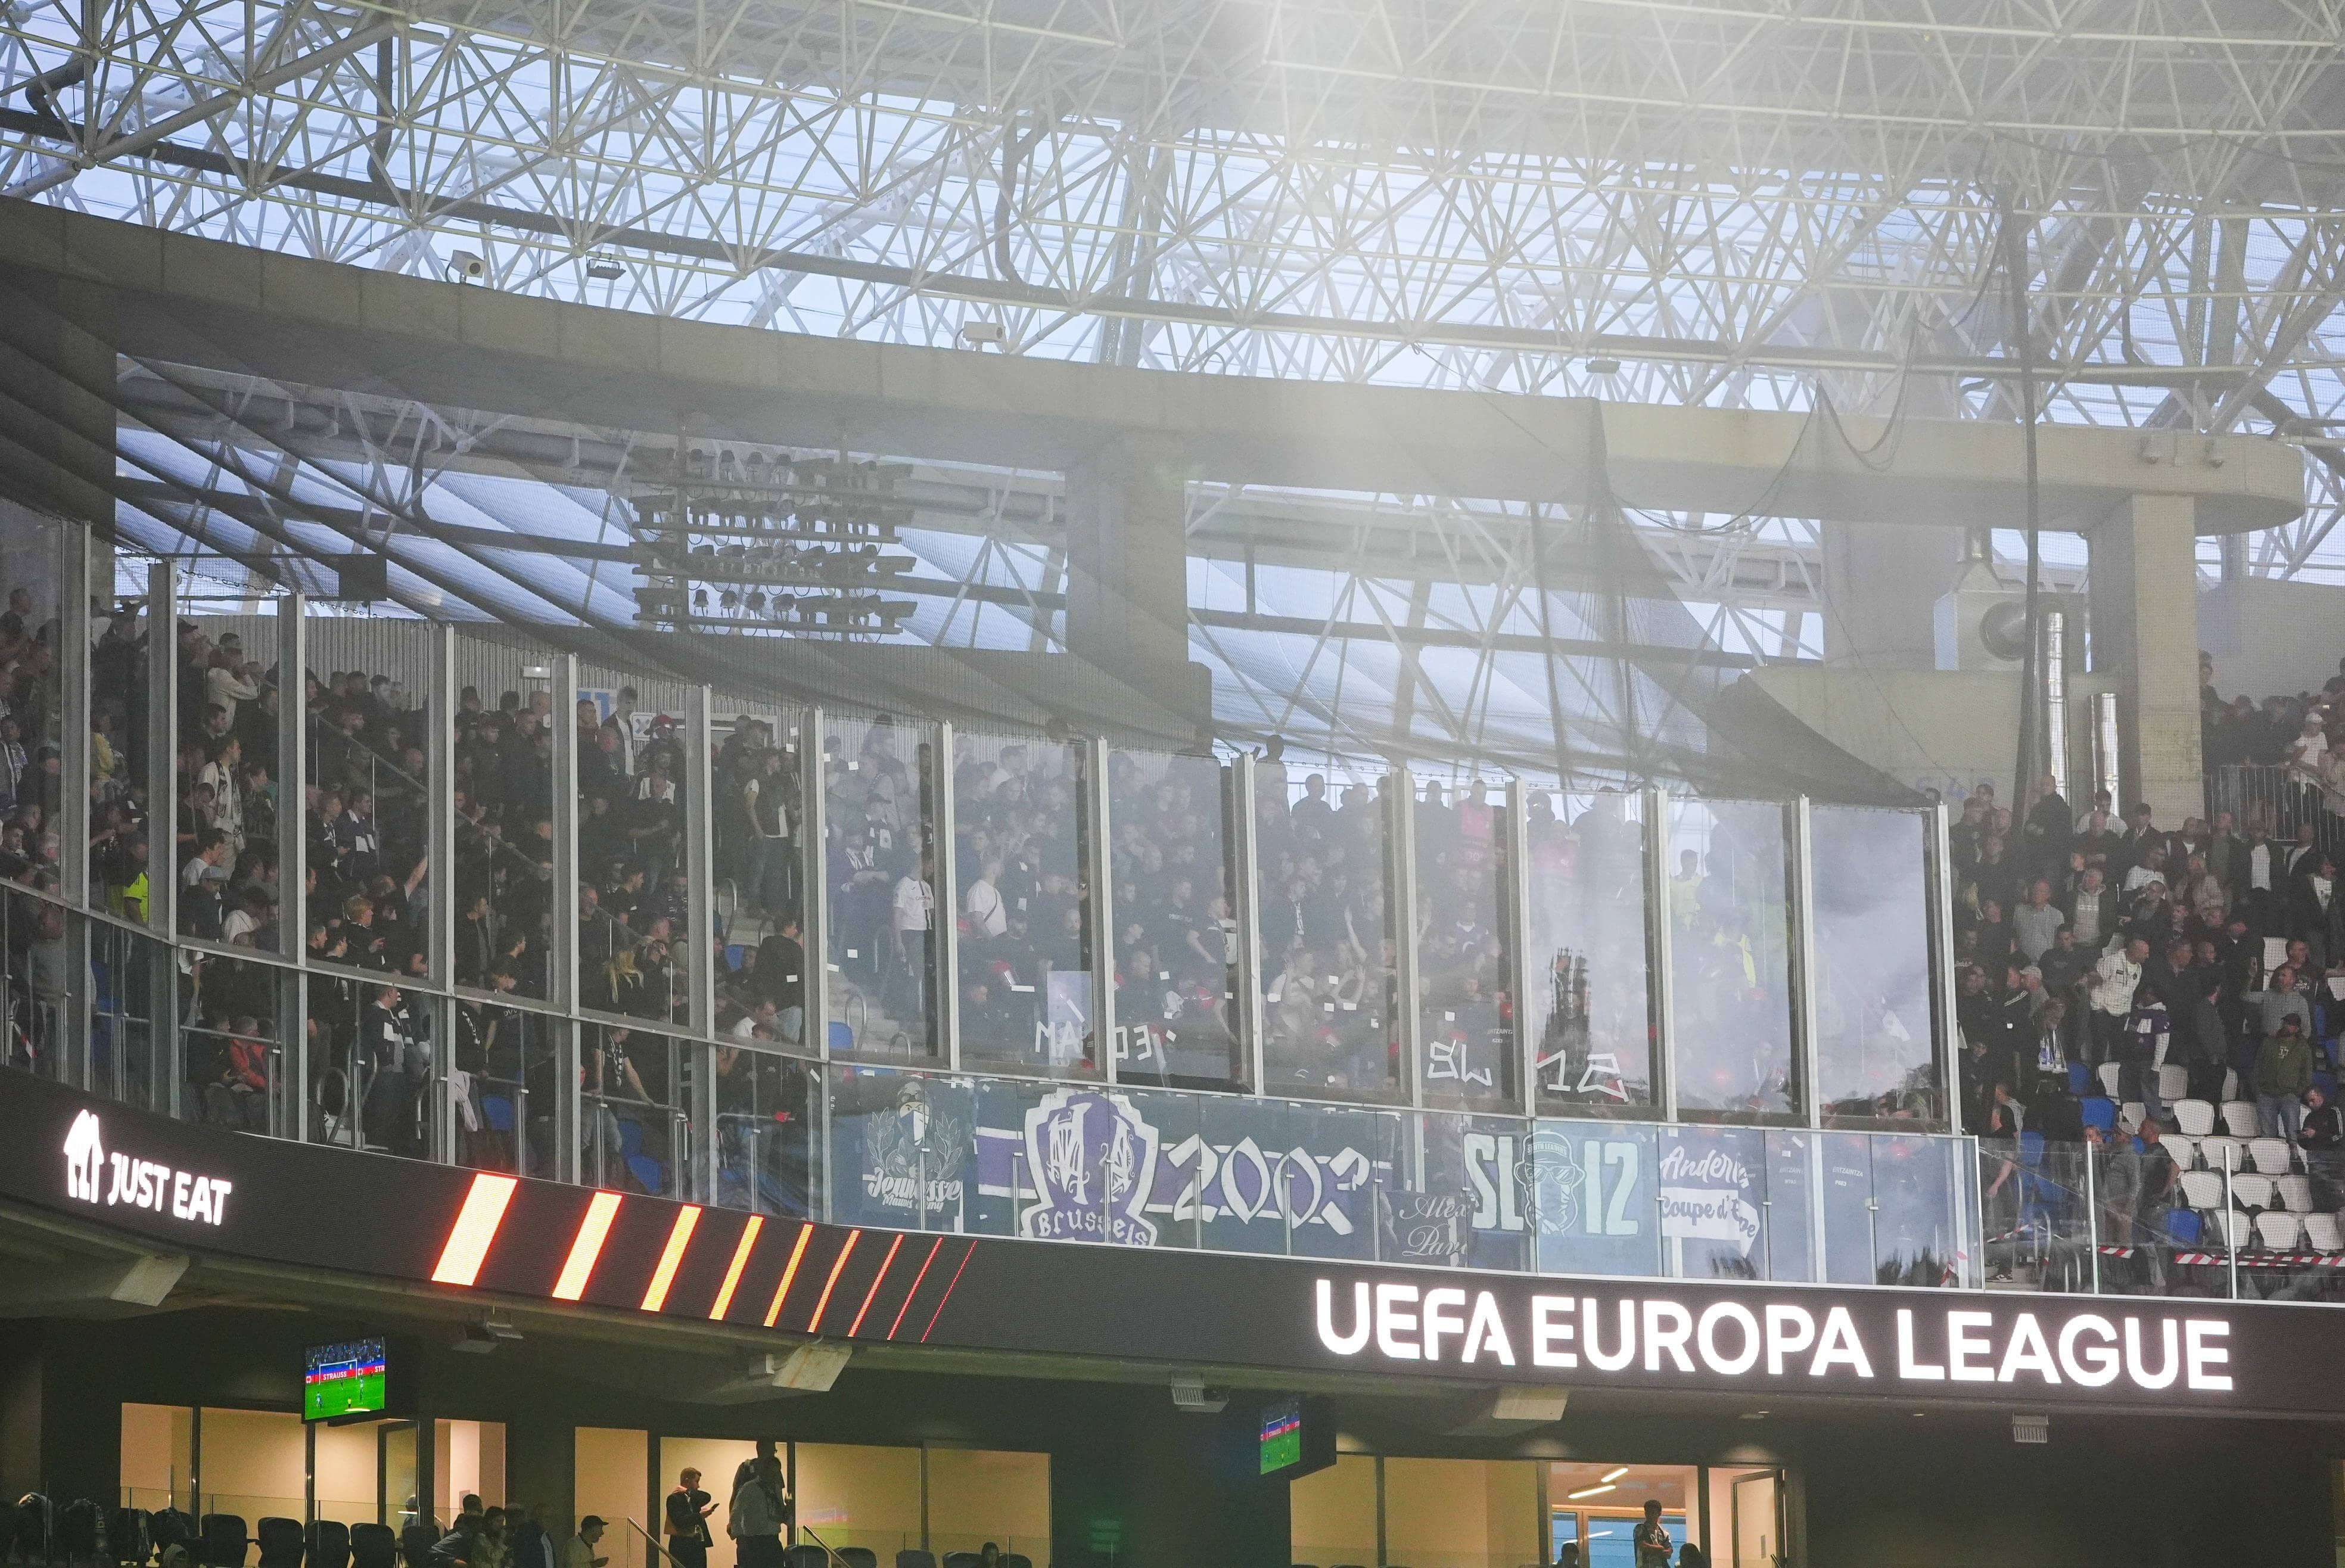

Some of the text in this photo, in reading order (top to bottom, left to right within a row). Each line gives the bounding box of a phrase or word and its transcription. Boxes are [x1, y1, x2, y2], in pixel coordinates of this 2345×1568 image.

[107, 1152, 232, 1225] JUST EAT
[1584, 1140, 1639, 1236] 12
[322, 1370, 347, 1380] STRAUSS
[1316, 1278, 2233, 1390] UEFA EUROPA LEAGUE
